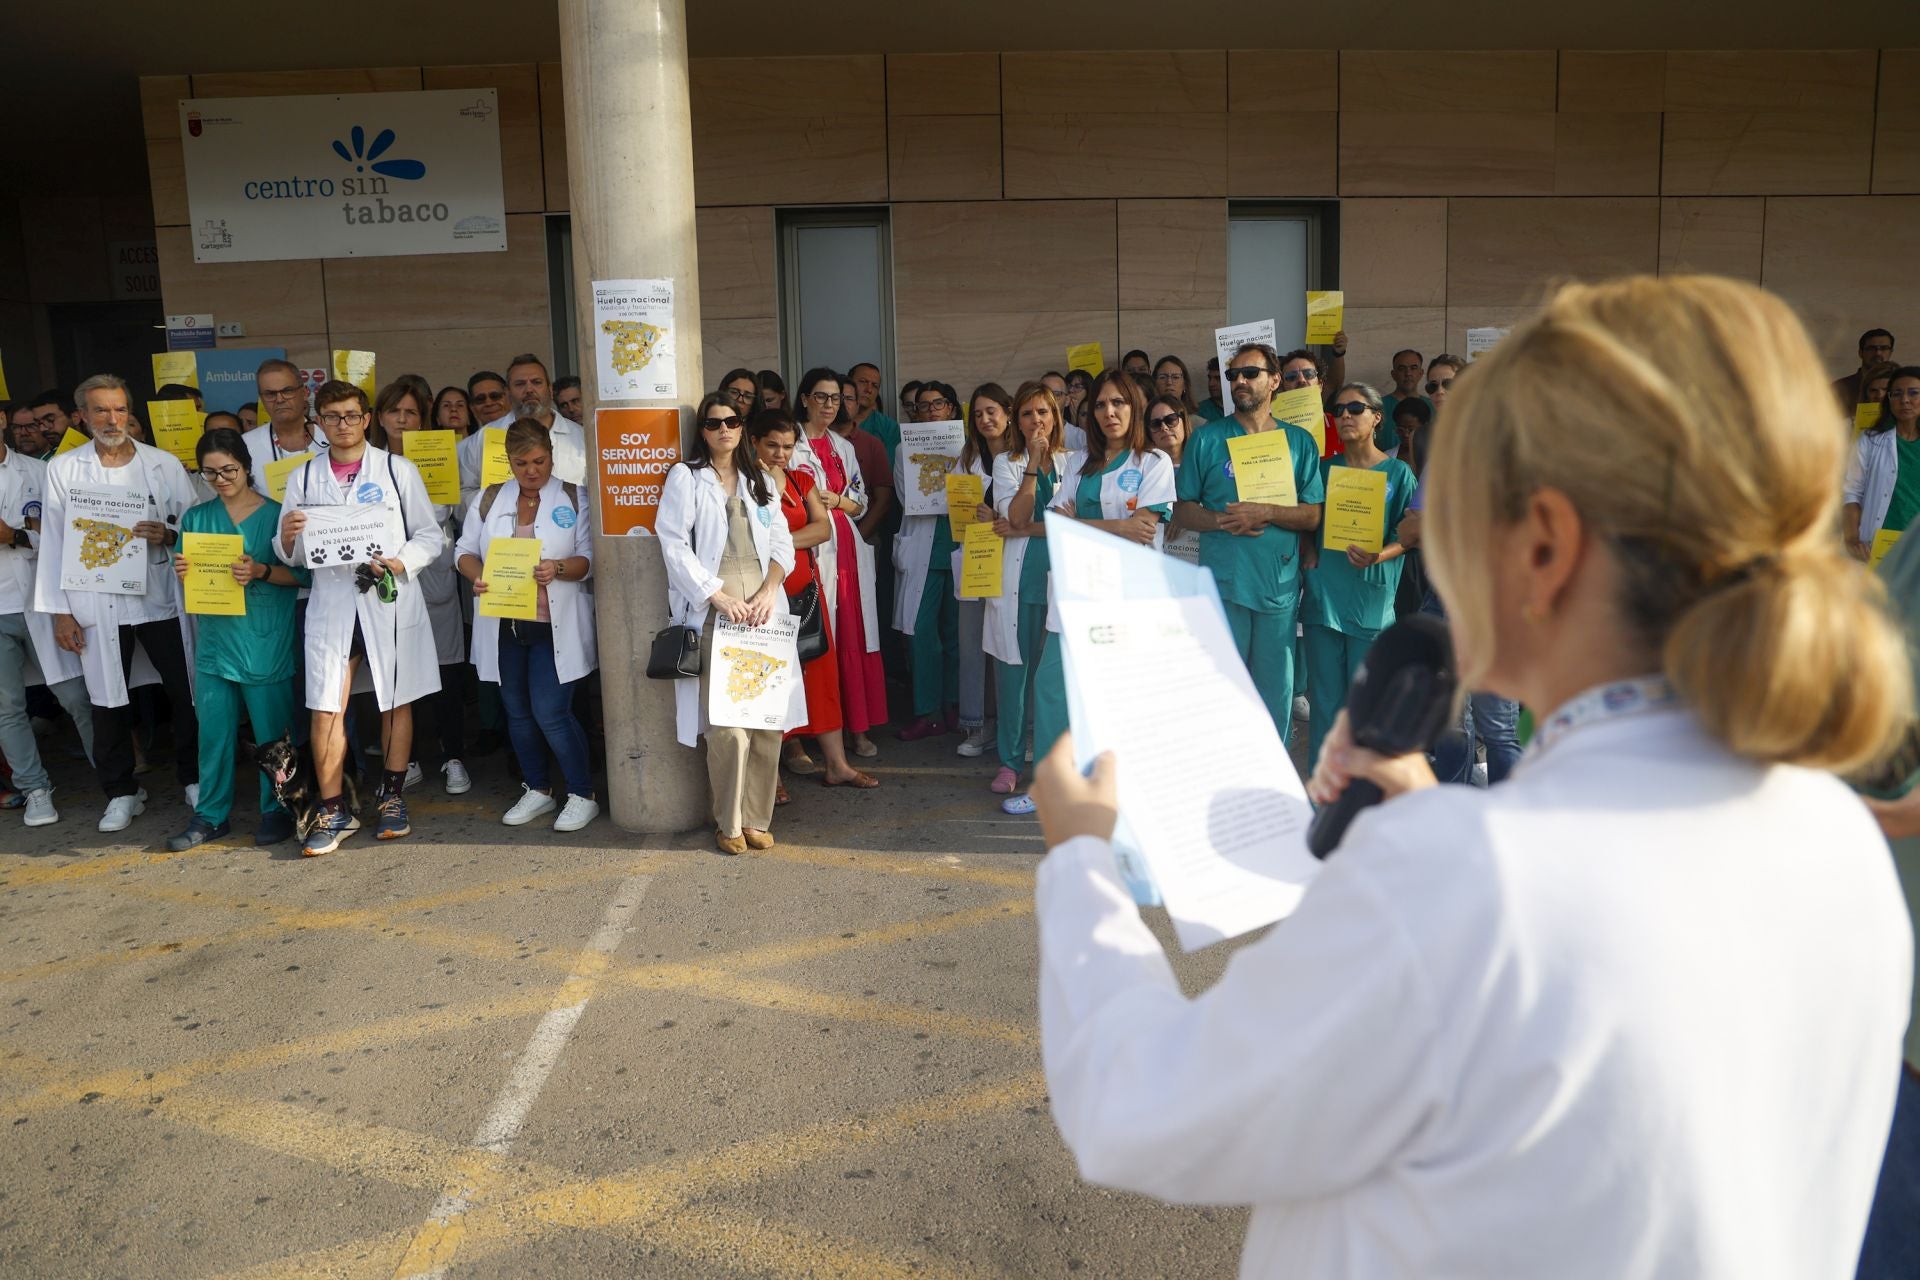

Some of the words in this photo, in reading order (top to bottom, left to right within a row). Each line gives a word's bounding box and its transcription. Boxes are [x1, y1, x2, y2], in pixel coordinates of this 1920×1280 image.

[245, 176, 334, 200] centro
[342, 176, 389, 197] sin
[343, 199, 449, 225] tabaco
[119, 246, 159, 265] ACCES
[126, 275, 157, 292] SOLO
[597, 296, 628, 305] Huelga
[631, 296, 670, 304] nacional
[1220, 339, 1245, 347] Huelga
[1246, 332, 1273, 343] nacional
[206, 371, 256, 382] Ambulan
[620, 433, 651, 446] SOY
[602, 447, 676, 460] SERVICIOS
[607, 461, 671, 475] MÍNIMOS
[606, 485, 619, 495] YO
[621, 485, 659, 494] APOYO
[70, 495, 102, 506] Huelga
[105, 500, 145, 510] nacional
[614, 495, 659, 506] HUELG
[360, 522, 384, 530] DUEÑO
[342, 536, 365, 544] HORAS
[1168, 544, 1200, 553] naciona
[719, 622, 752, 633] Huelga
[755, 627, 794, 637] nacional
